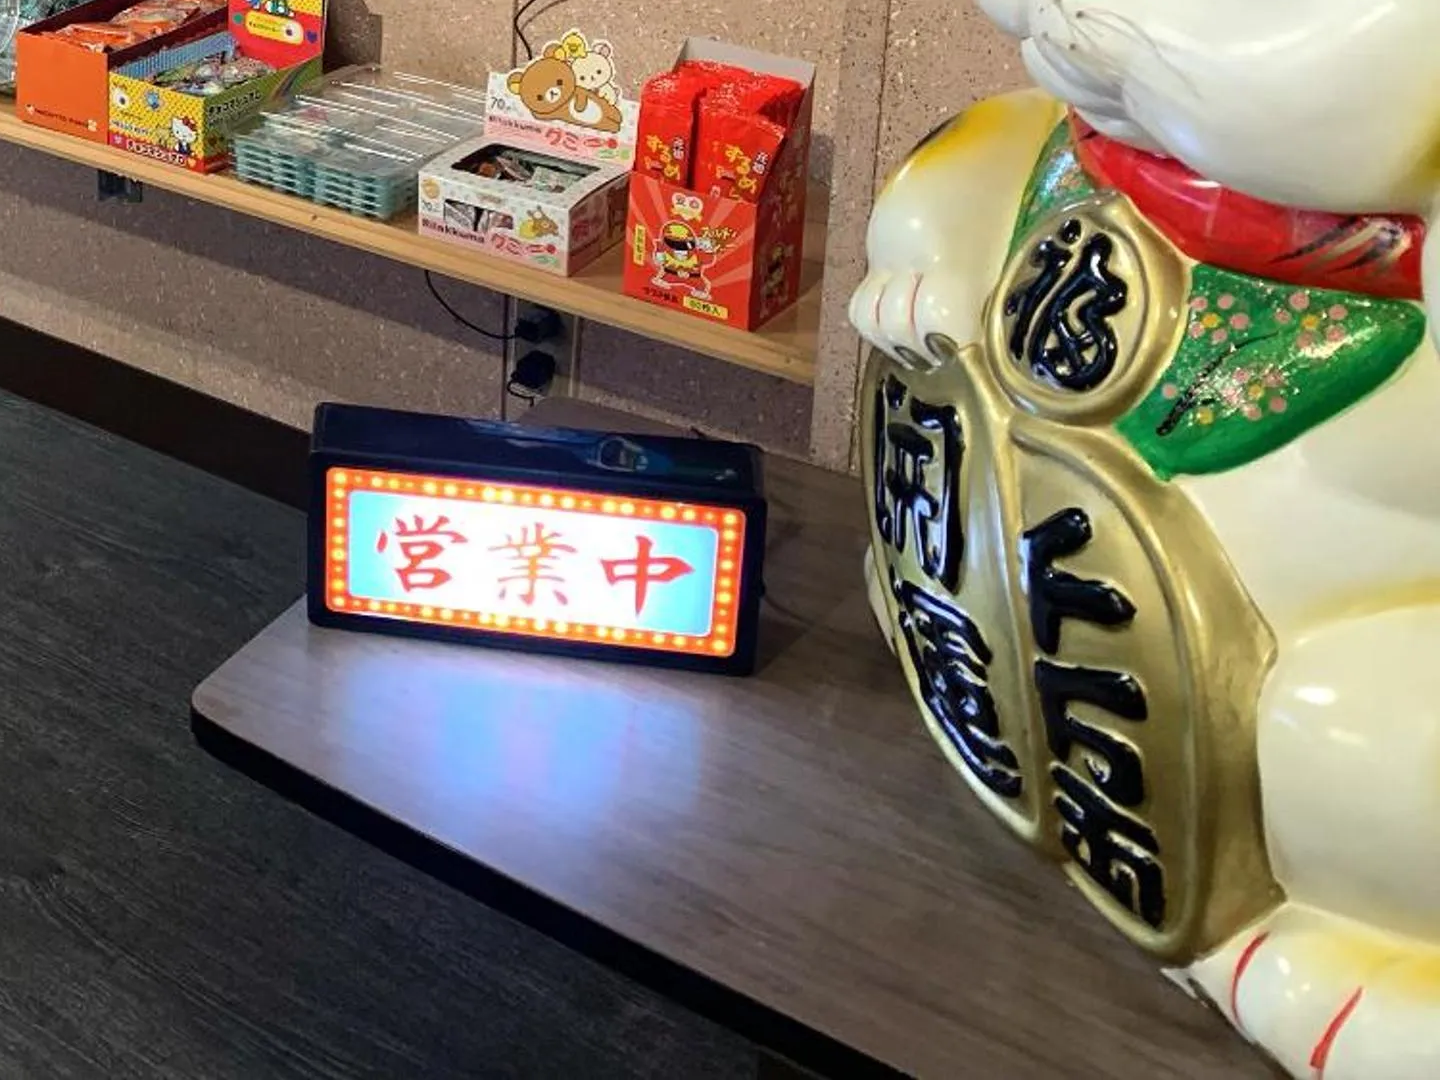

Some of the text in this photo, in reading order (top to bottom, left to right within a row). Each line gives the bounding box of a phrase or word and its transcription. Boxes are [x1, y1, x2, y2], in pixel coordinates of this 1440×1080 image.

[544, 127, 580, 152] グミ
[724, 142, 759, 194] するめ
[490, 233, 523, 257] グミ
[375, 511, 696, 617] 営業中
[1021, 504, 1168, 931] 千万両
